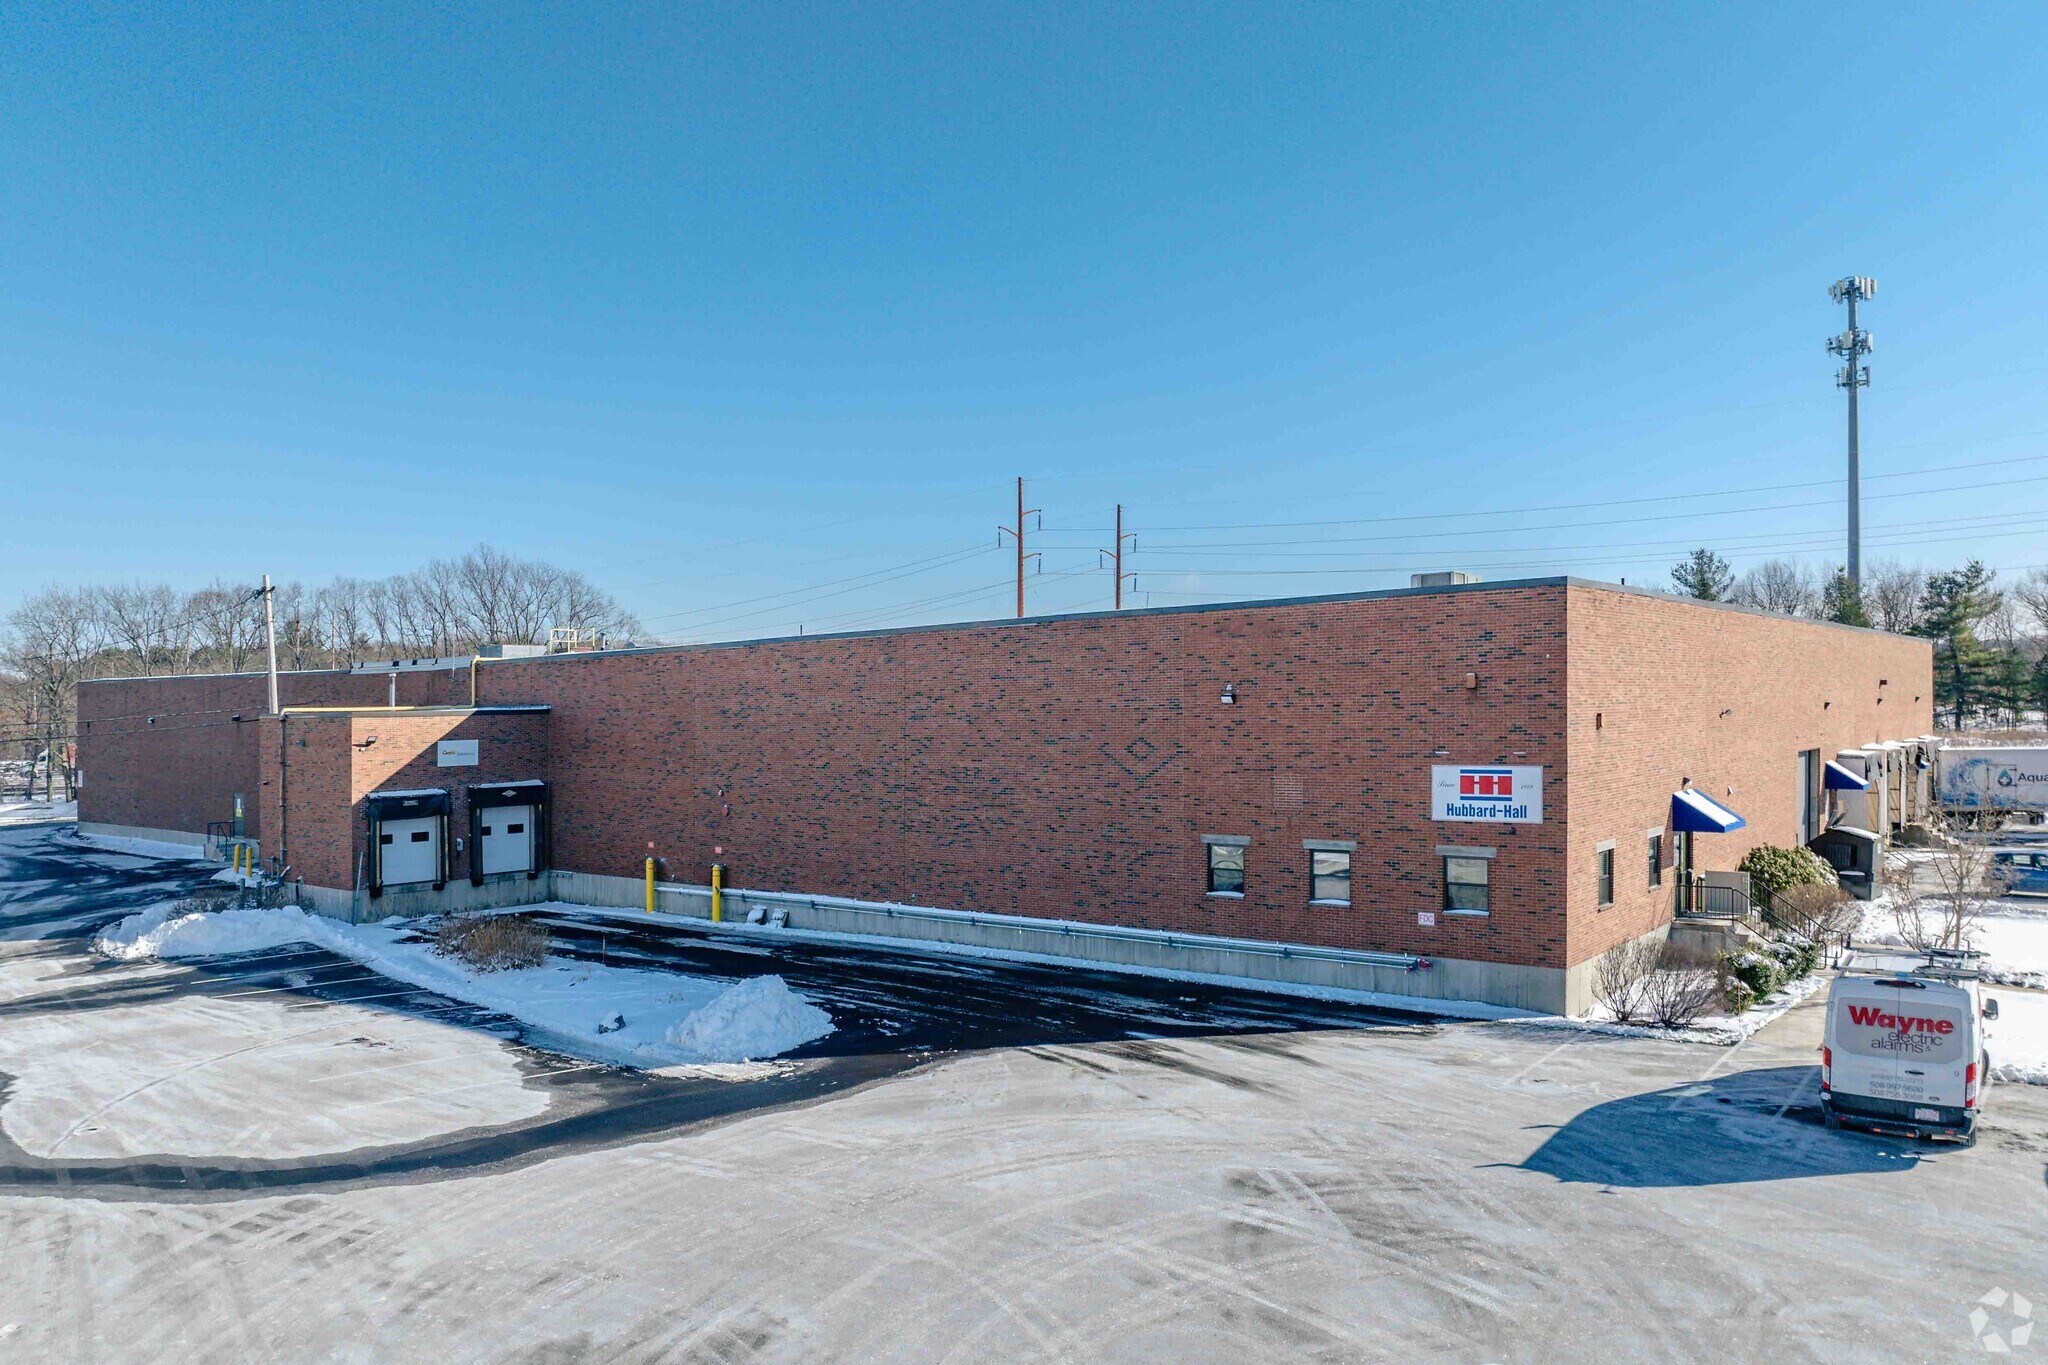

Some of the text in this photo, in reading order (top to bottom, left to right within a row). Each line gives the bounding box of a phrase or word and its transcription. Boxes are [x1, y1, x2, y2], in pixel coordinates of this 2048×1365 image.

[1446, 803, 1528, 819] Hubbard-Hall
[1420, 915, 1434, 923] FDC
[1848, 1005, 1954, 1035] Wayne
[1871, 1037, 1924, 1054] alarms
[1888, 1031, 1943, 1047] electric
